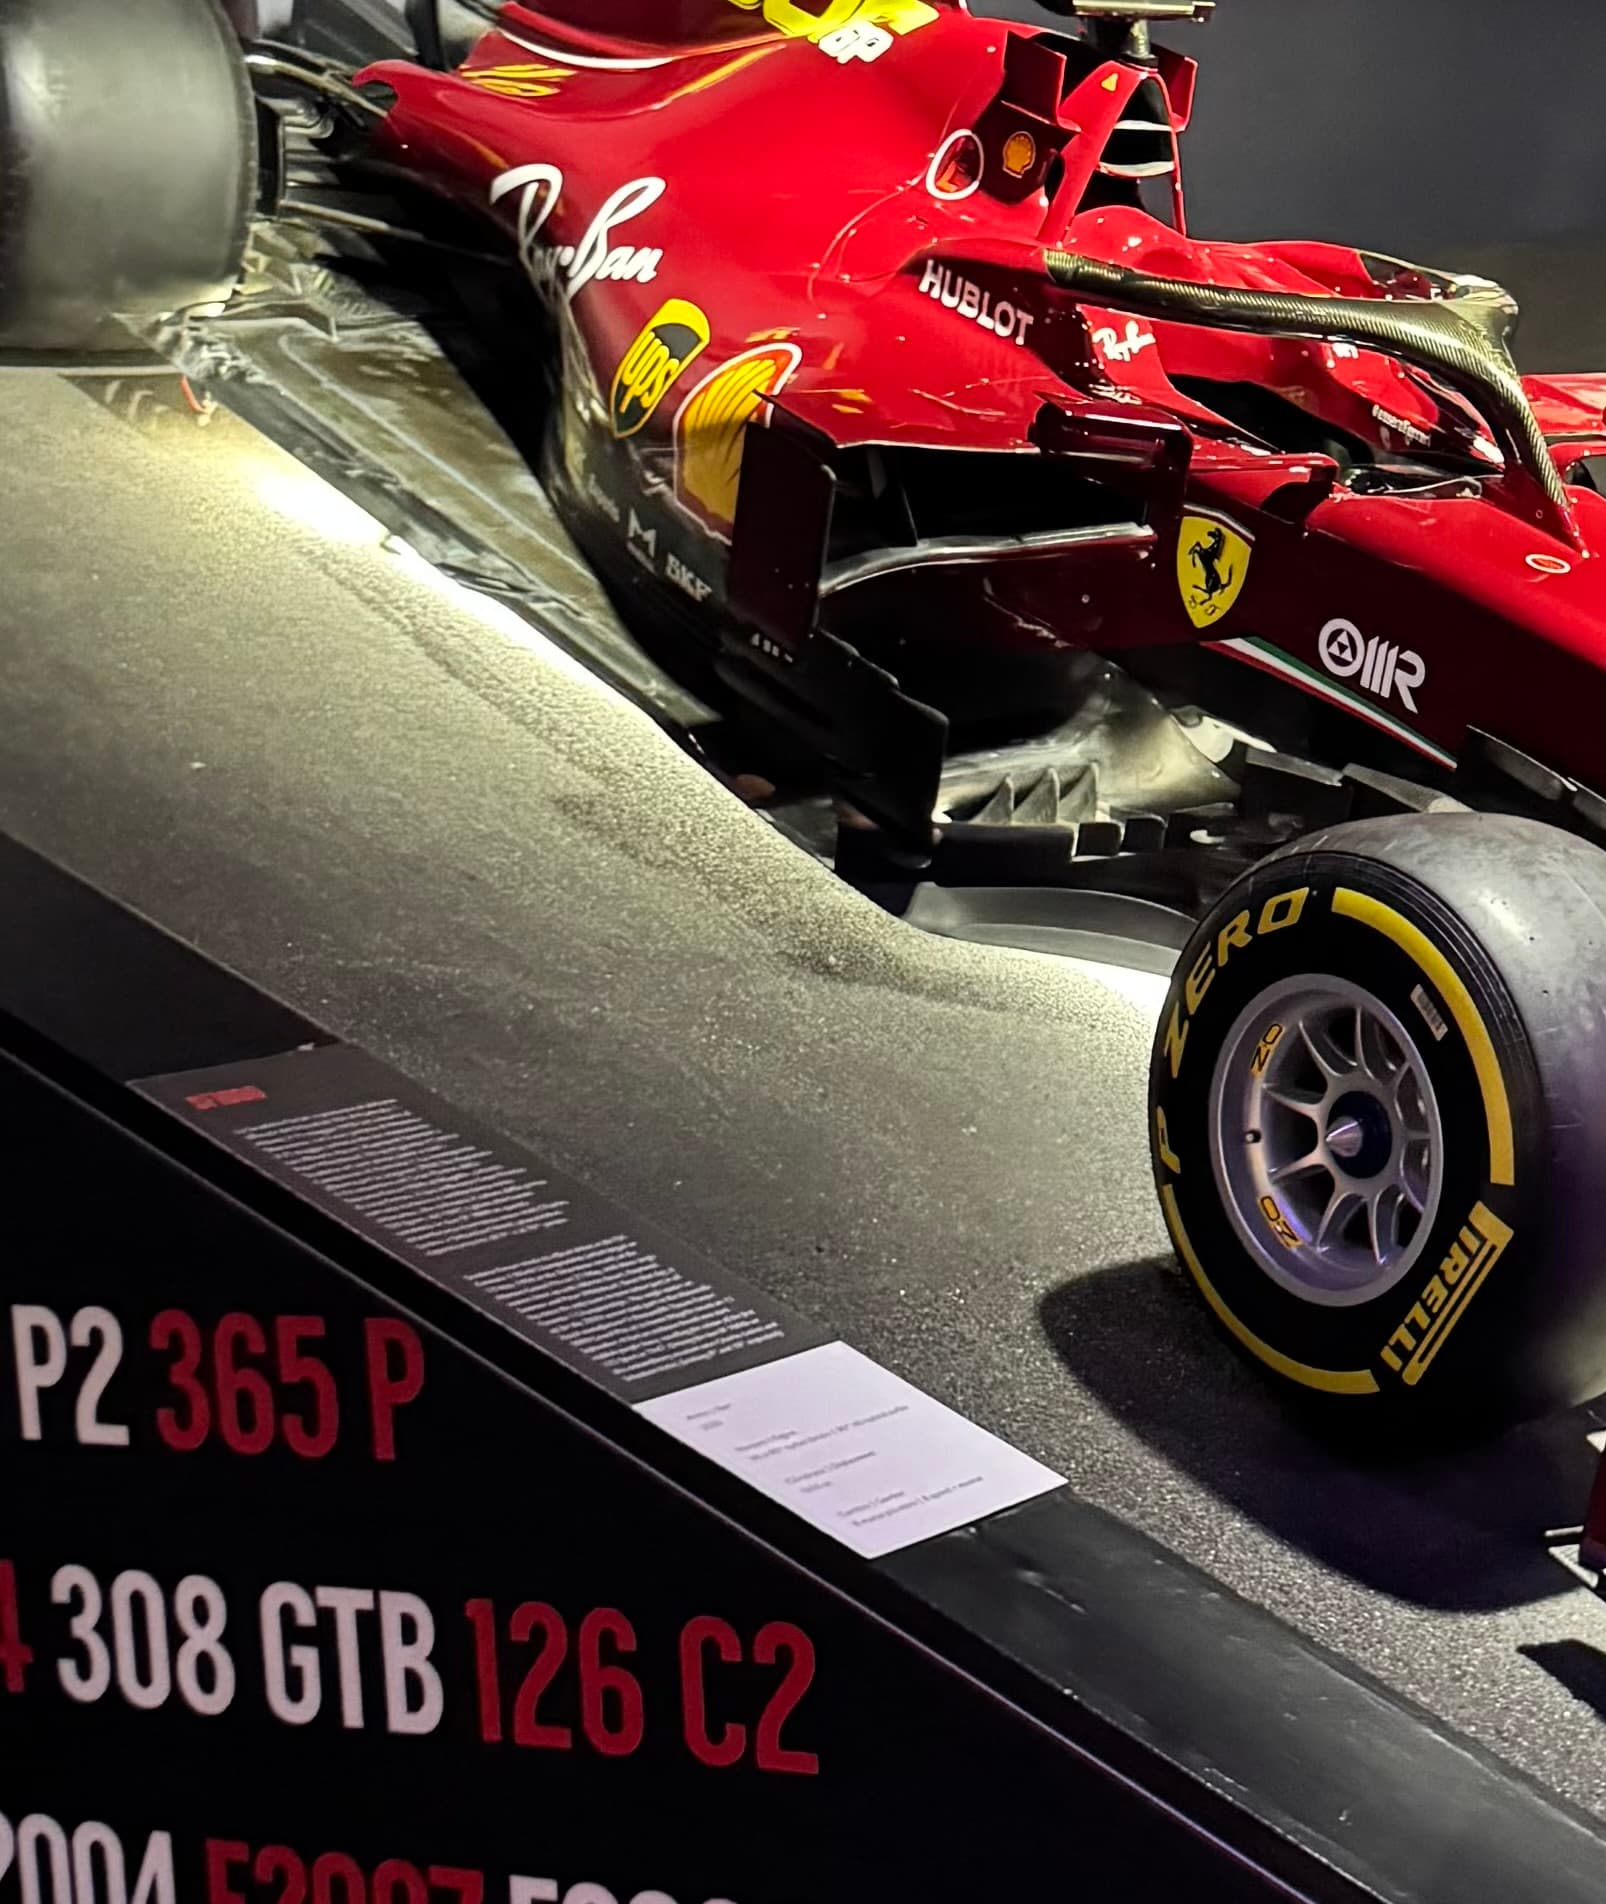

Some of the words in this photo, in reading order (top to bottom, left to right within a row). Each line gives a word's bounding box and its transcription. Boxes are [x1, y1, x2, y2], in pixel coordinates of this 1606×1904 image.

[619, 330, 681, 414] ups
[918, 259, 1034, 346] HUBLOT
[1164, 886, 1310, 1079] ZERO
[1156, 1104, 1181, 1174] P
[1379, 1199, 1516, 1386] PIRELLI
[11, 1303, 130, 1446] P2
[149, 1308, 340, 1459] 365
[363, 1317, 426, 1461] P
[50, 1564, 236, 1715] 308
[258, 1581, 444, 1735] GTB
[464, 1598, 644, 1757] 126
[679, 1615, 820, 1775] C2
